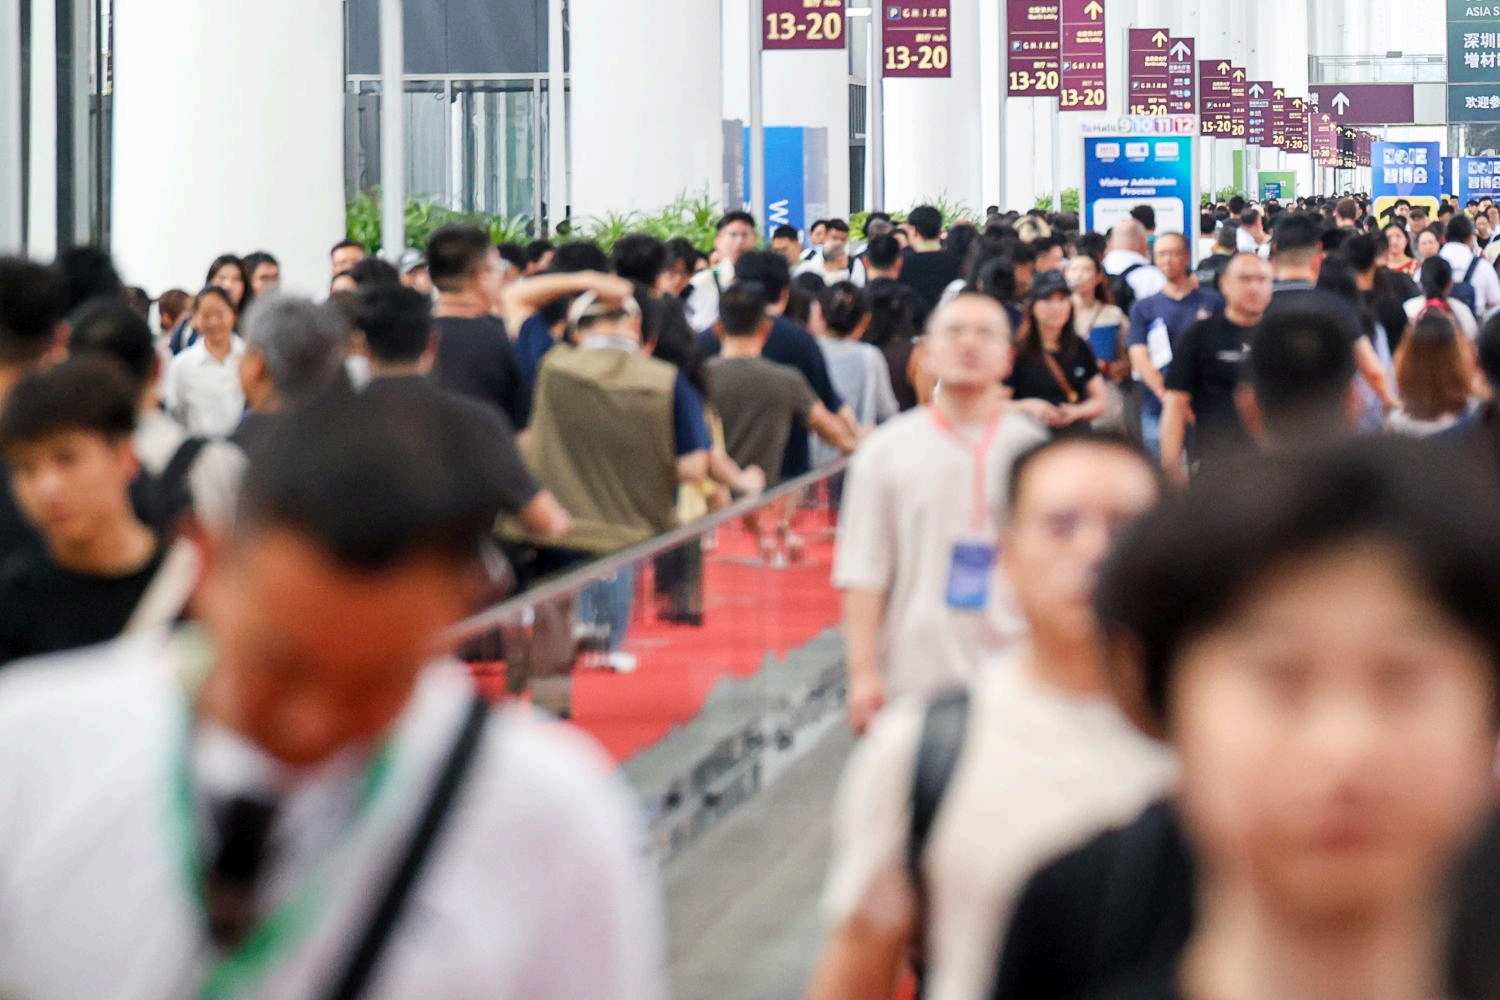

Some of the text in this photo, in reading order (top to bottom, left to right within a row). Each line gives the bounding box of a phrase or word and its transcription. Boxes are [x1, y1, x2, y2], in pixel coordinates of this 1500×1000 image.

[1466, 6, 1491, 16] ASIA
[766, 12, 842, 40] 13-20
[885, 46, 948, 70] 13-20
[1009, 71, 1059, 90] 13-20
[1060, 89, 1105, 106] 13-20
[1202, 121, 1231, 132] 15-20
[1285, 140, 1303, 149] 7-20
